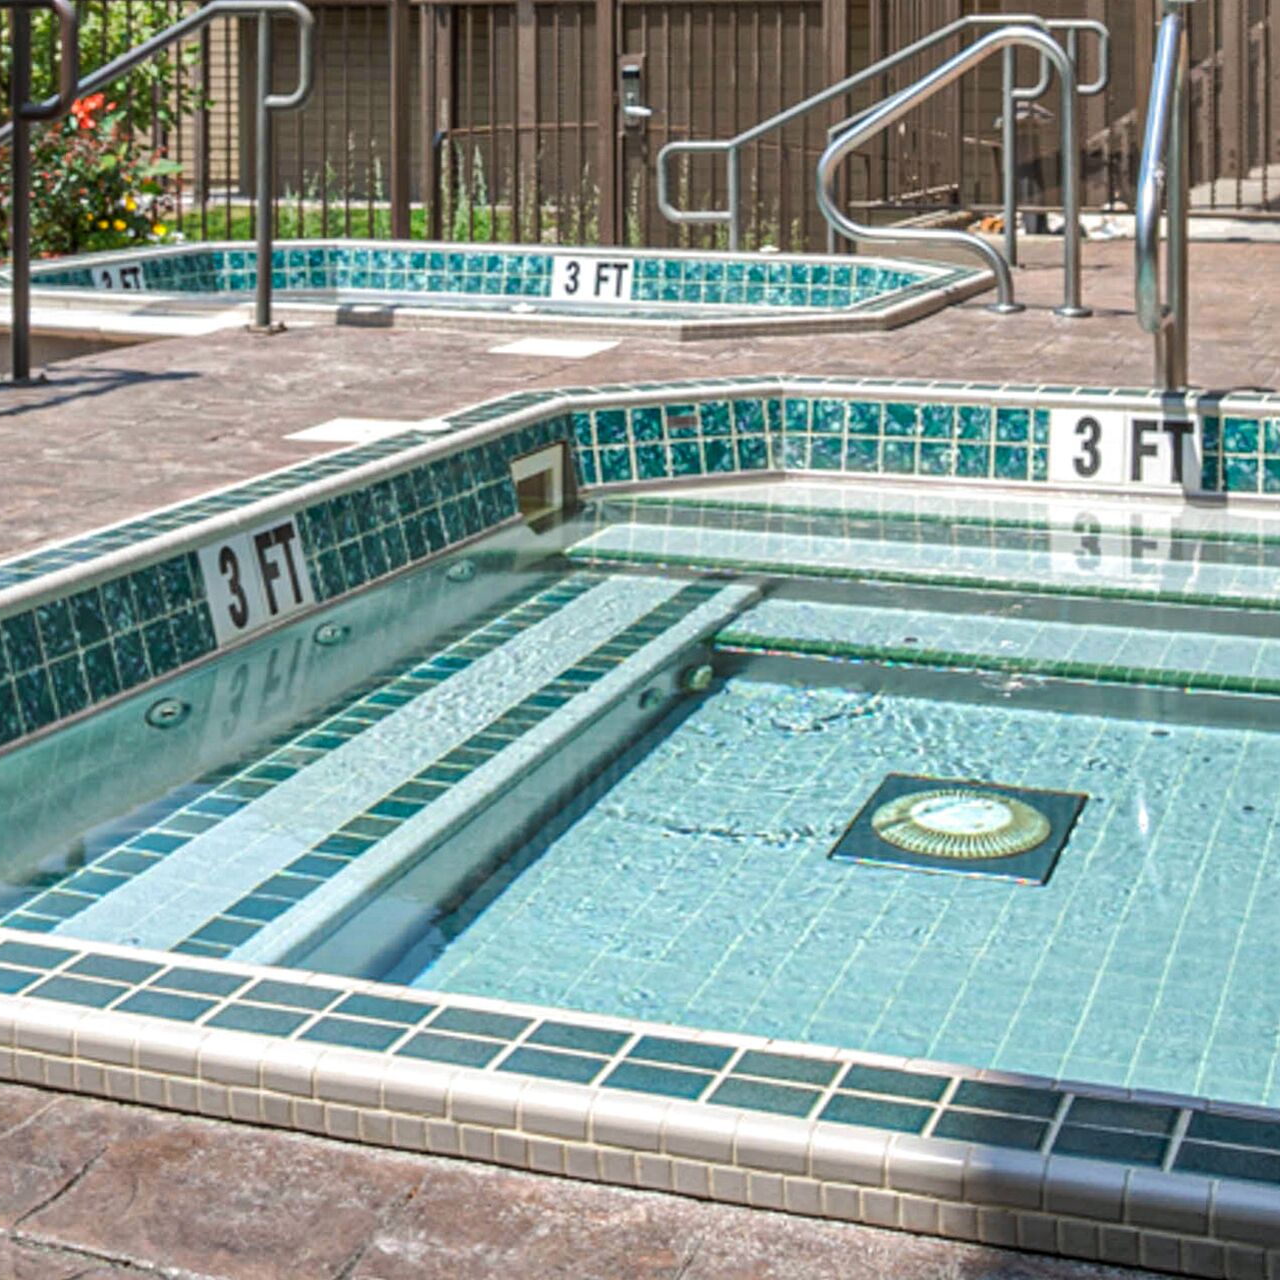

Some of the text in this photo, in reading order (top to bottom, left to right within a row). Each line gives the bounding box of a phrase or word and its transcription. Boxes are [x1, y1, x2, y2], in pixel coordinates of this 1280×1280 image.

[564, 260, 629, 298] 3 FT
[1073, 417, 1195, 483] 3 FT
[218, 521, 303, 629] 3 FT
